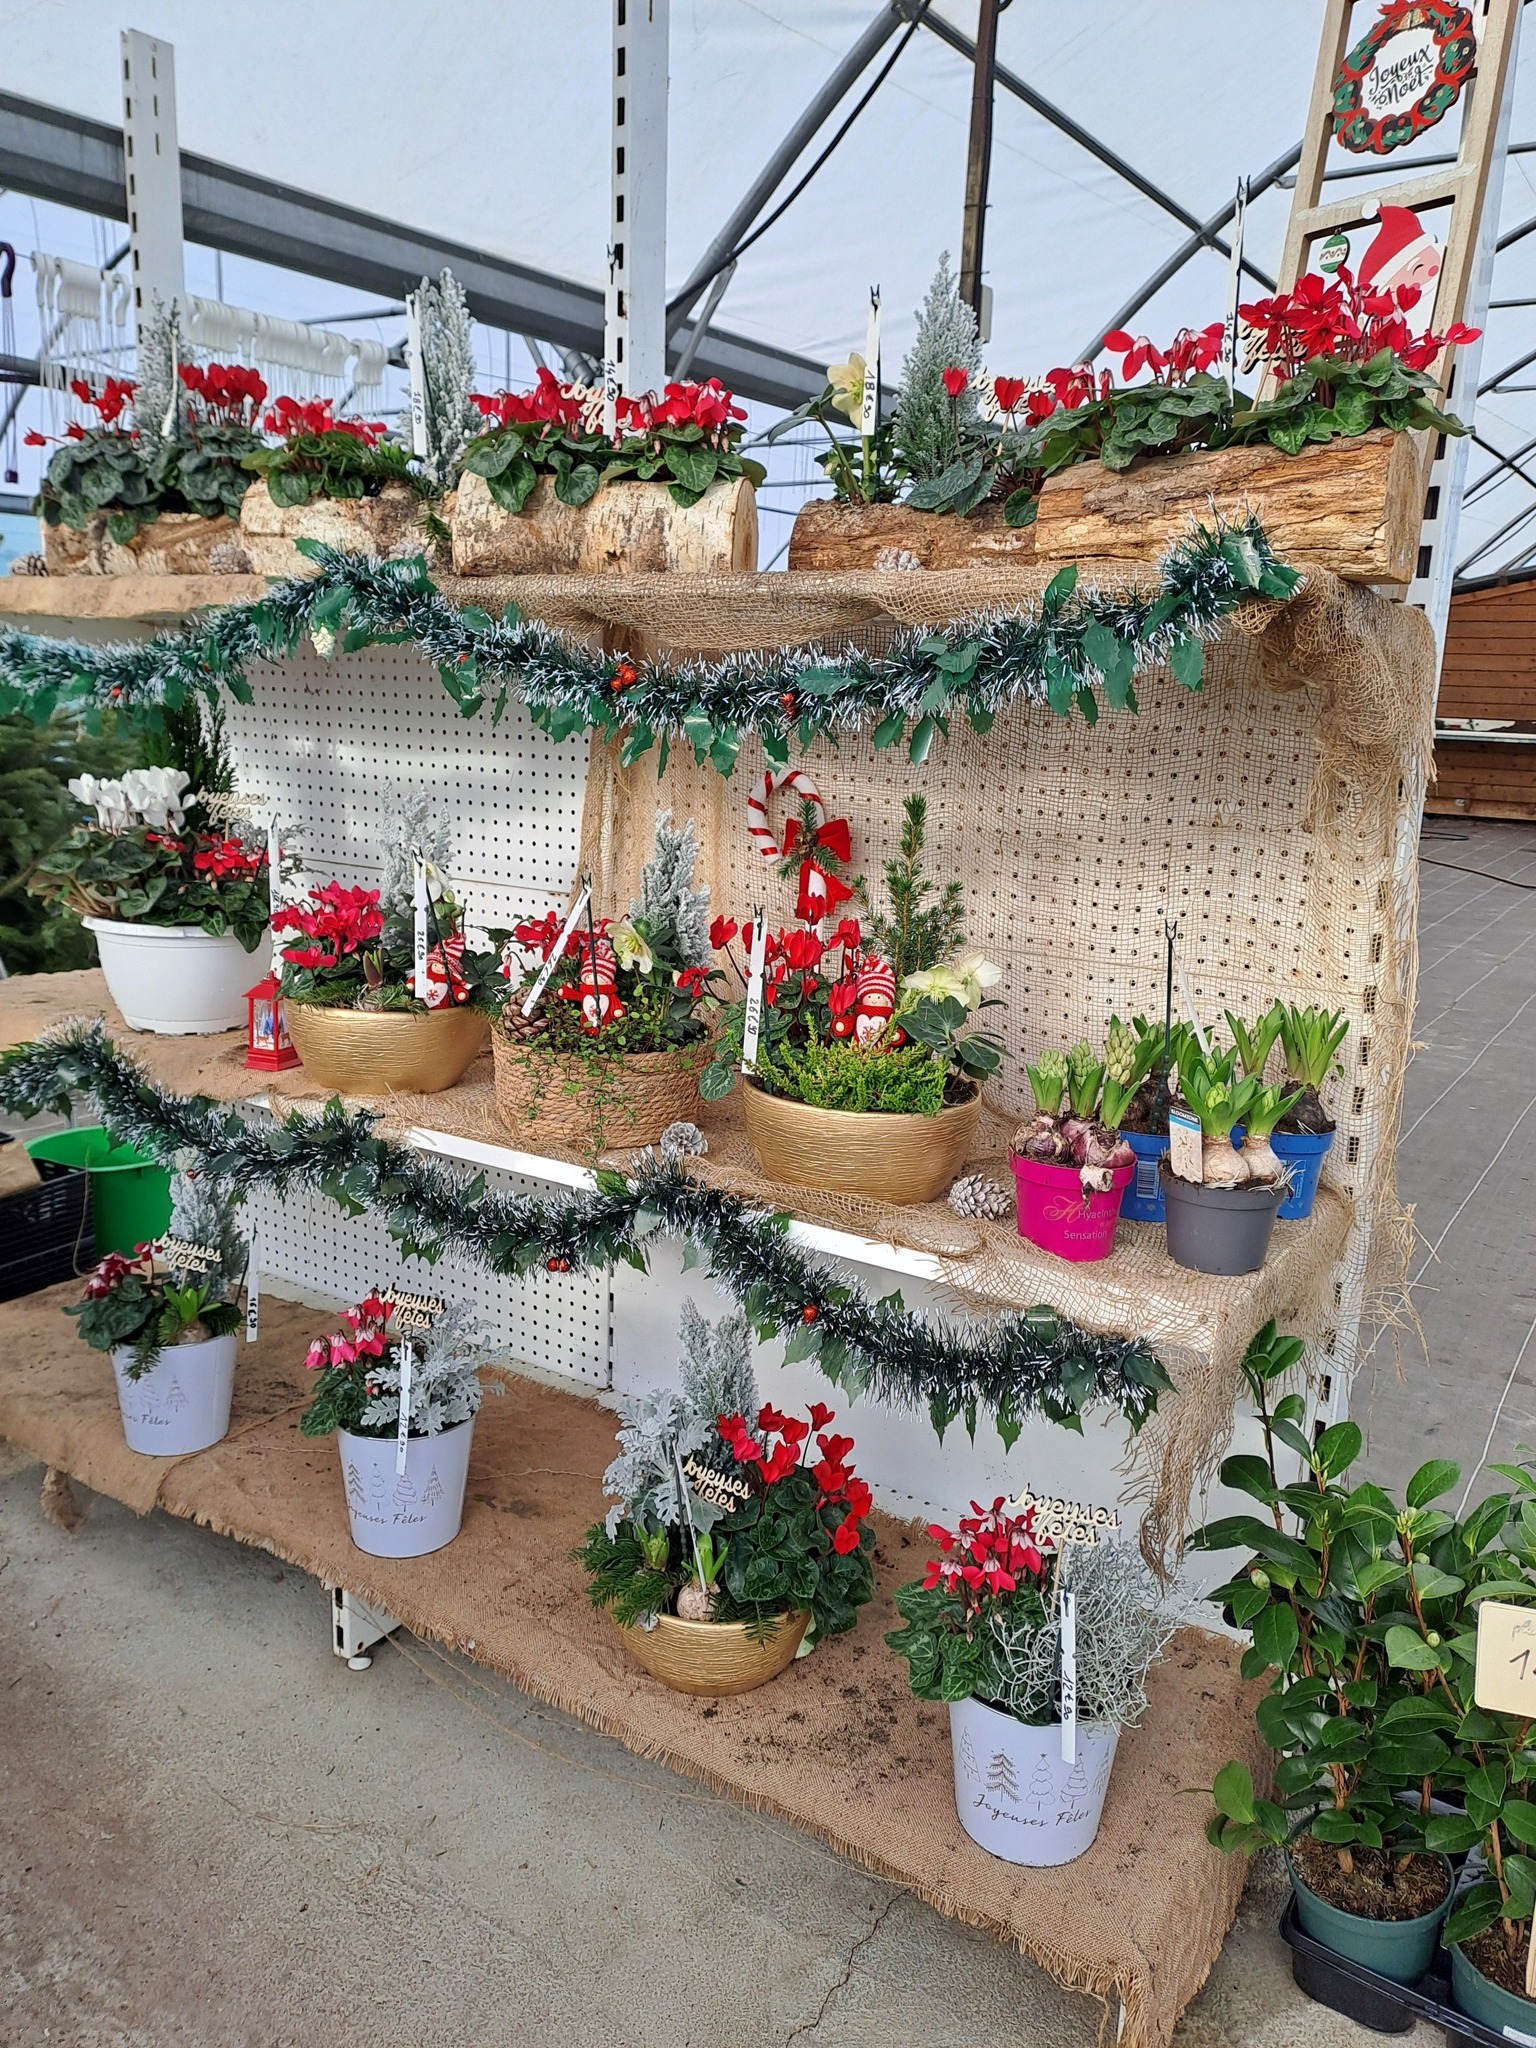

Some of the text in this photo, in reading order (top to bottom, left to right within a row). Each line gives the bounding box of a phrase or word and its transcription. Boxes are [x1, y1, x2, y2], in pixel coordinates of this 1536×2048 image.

[1369, 44, 1434, 95] Joyeux
[1374, 64, 1433, 106] Noël
[152, 1230, 222, 1263] Joyeuses
[1064, 1230, 1108, 1240] Sensation
[379, 1284, 446, 1315] Joyeuses
[1006, 1485, 1122, 1530] Joyeuses
[1509, 1648, 1536, 1681] 1
[973, 1793, 1049, 1828] Joyeuses
